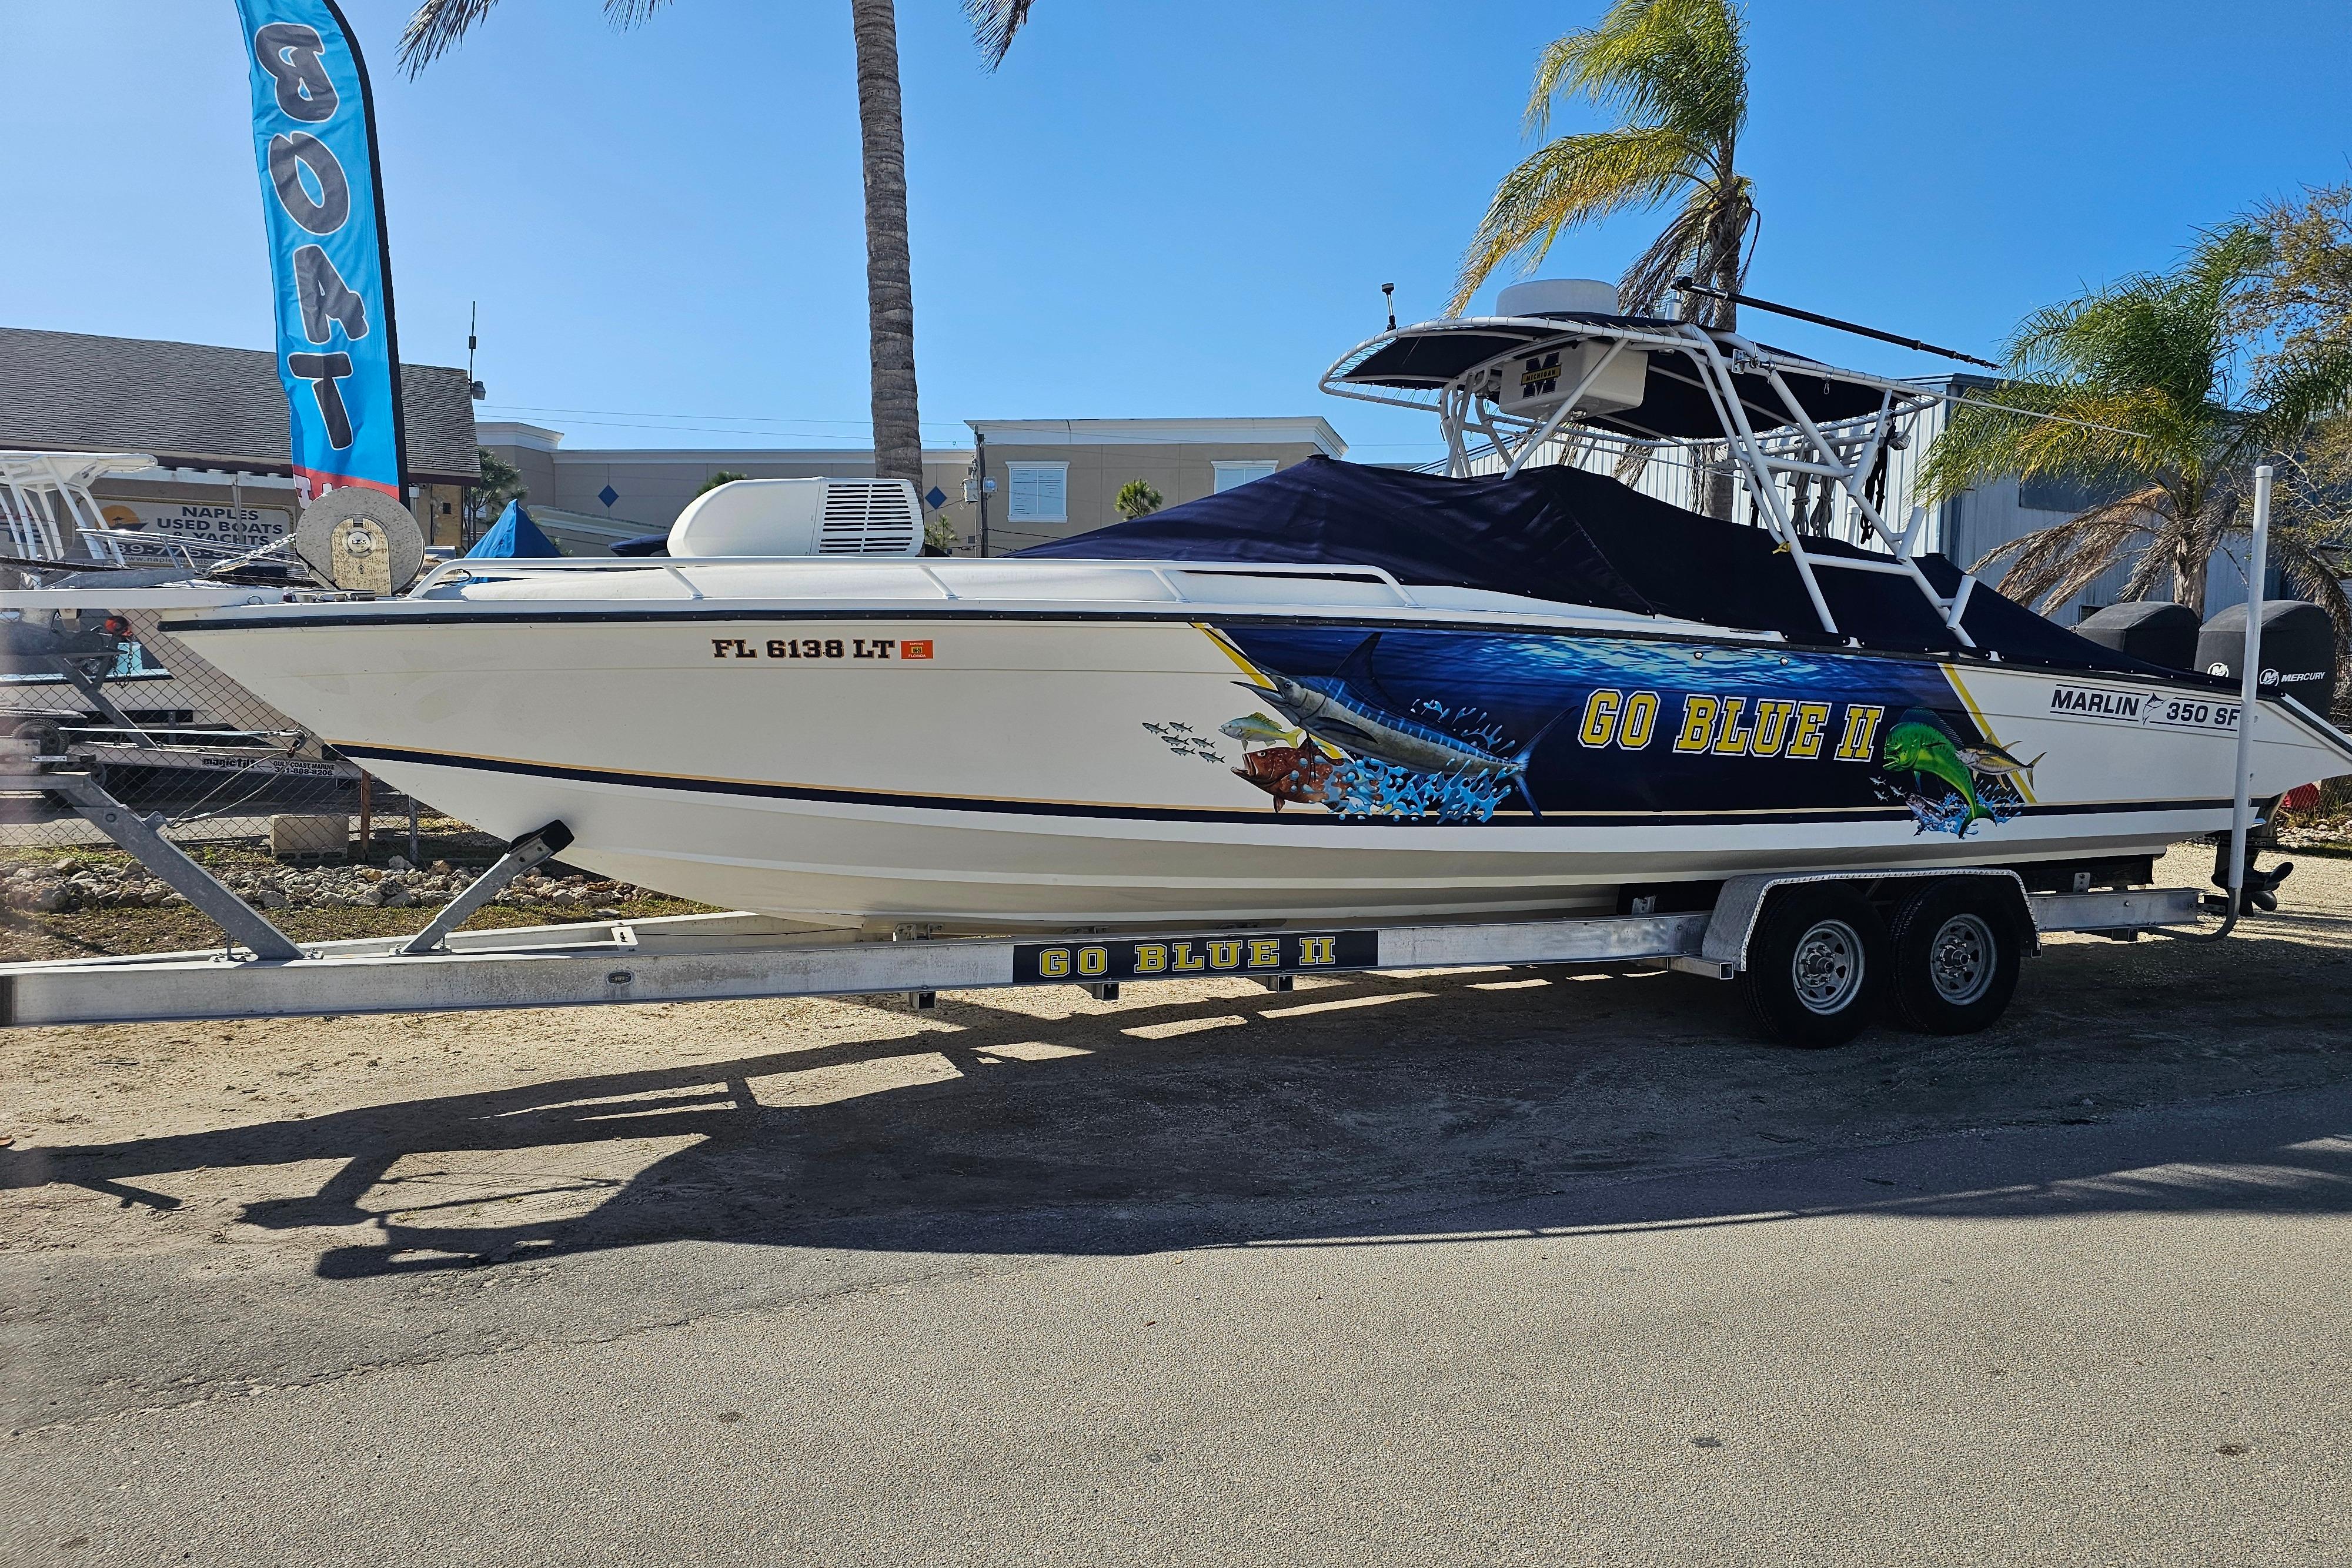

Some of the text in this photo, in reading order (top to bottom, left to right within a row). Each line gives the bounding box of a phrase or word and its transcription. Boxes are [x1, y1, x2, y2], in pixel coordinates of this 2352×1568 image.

[1526, 369, 1556, 382] MICHIGAN
[182, 506, 259, 521] NAPLES
[157, 517, 283, 534] USED BOATS
[711, 638, 896, 659] FL 6138 LT
[2280, 671, 2326, 683] MERCURY
[2050, 689, 2241, 726] MARLIN 350 SF
[1578, 687, 1885, 763] GO BLUE II
[1040, 936, 1335, 978] GO BLUE II
